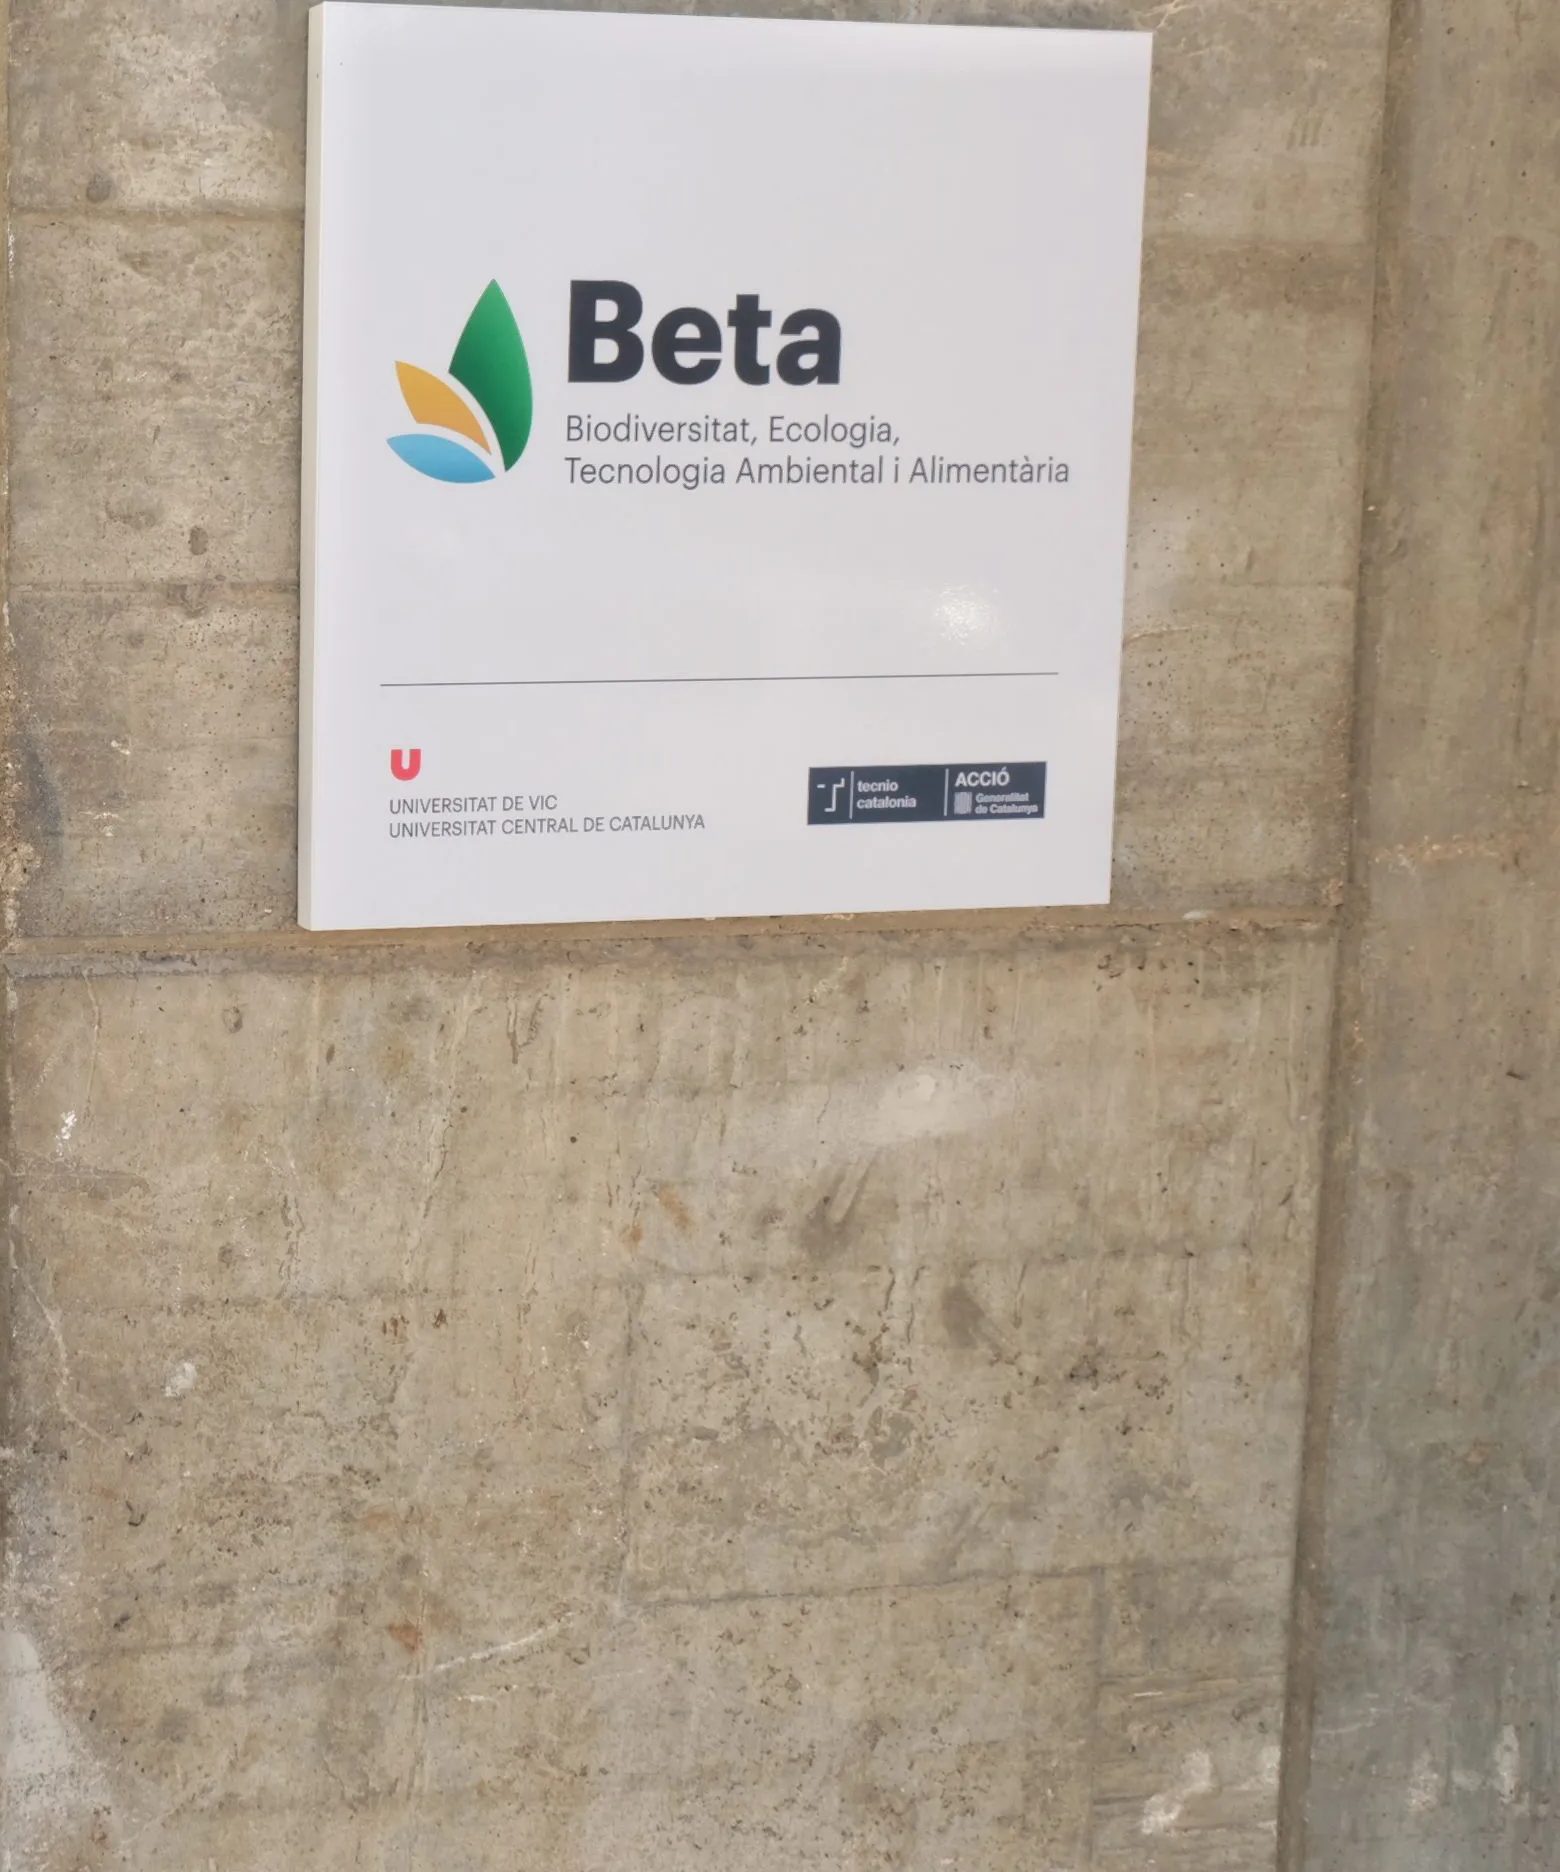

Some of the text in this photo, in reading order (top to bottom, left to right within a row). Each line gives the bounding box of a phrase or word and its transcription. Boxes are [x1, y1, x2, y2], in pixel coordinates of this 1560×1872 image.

[567, 279, 842, 386] Beta
[566, 412, 900, 449] Biodiversitat, Ecologia,
[563, 454, 1070, 491] Tecnologia Ambiental i Alimentària
[856, 778, 899, 793] tecnio
[954, 766, 1010, 788] ACCIÓ
[389, 793, 558, 815] UNIVERSITAT DE VIC
[856, 795, 917, 810] catalonia
[389, 813, 706, 839] UNIVERSITAT CENTRAL DE CATALUNYA
